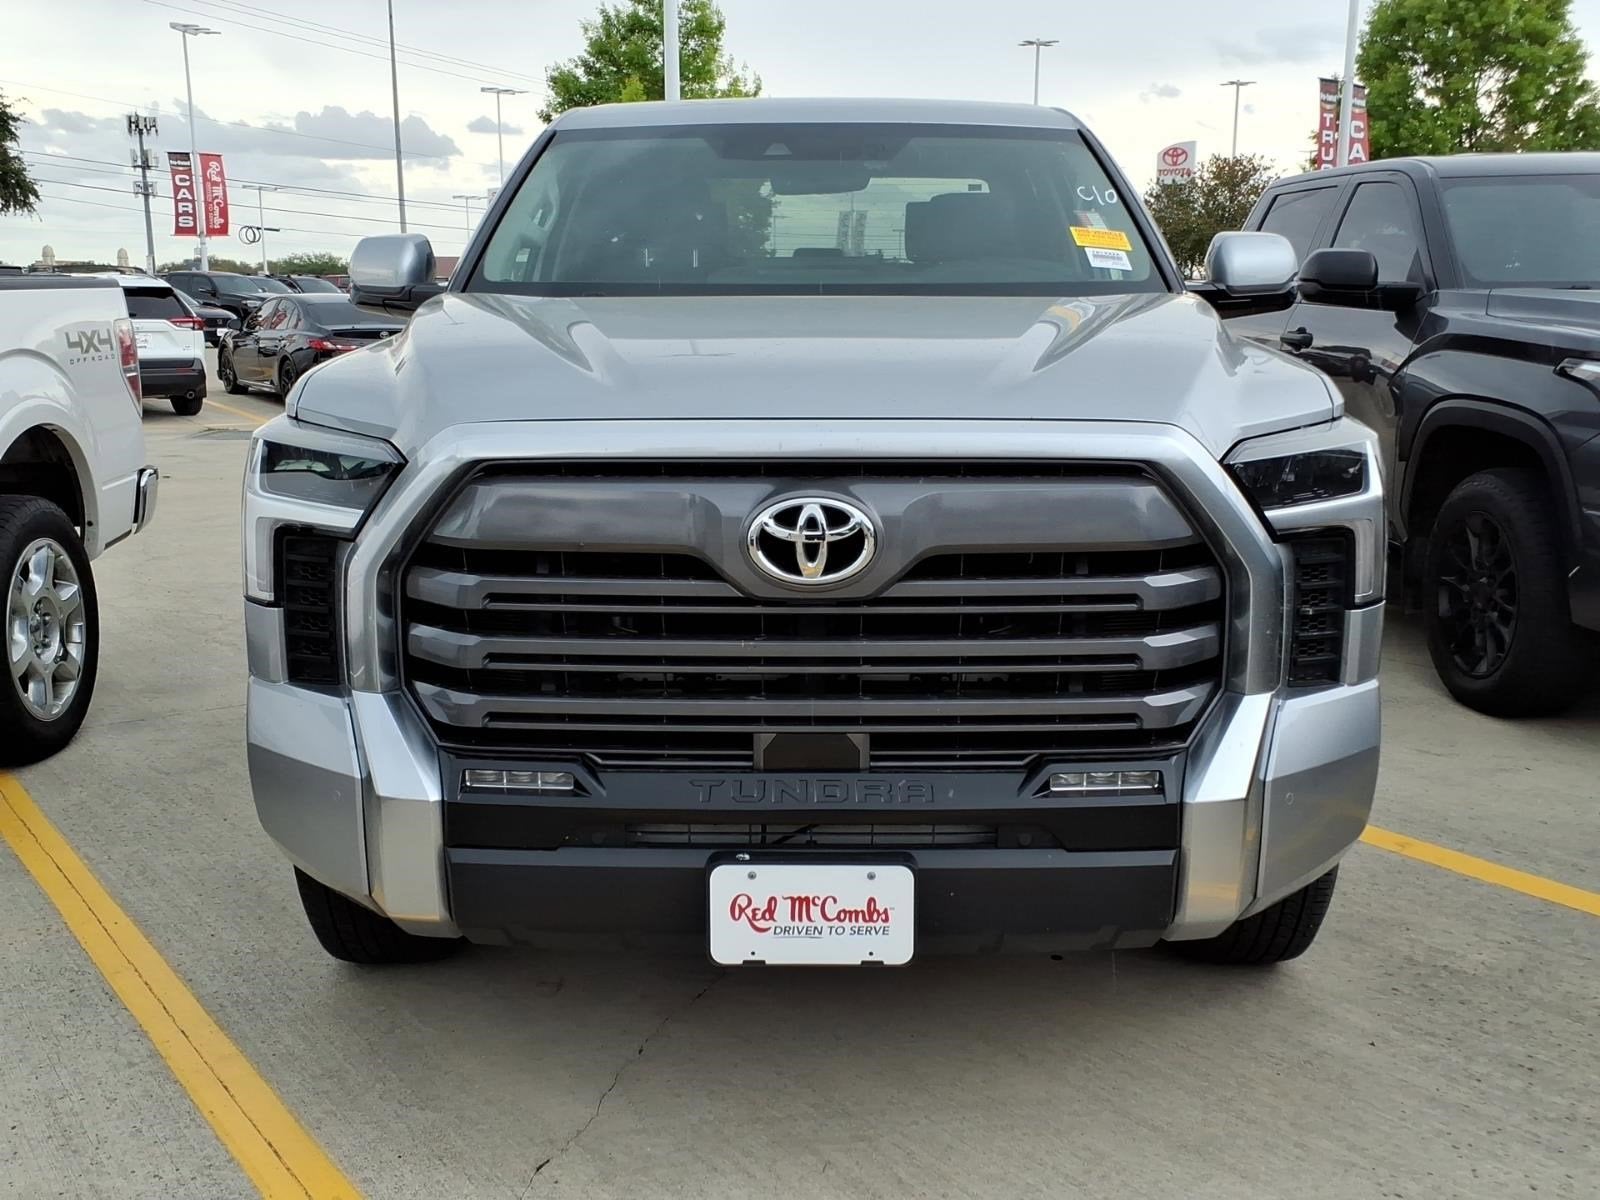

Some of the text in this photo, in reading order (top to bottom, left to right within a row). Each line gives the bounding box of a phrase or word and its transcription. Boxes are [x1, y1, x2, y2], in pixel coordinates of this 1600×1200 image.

[1158, 168, 1192, 177] TOYOTA
[174, 174, 194, 227] CARS
[689, 779, 935, 803] TUNDRA
[730, 893, 890, 933] Red McCombs
[773, 926, 890, 936] DRIVEN TO SERVE
